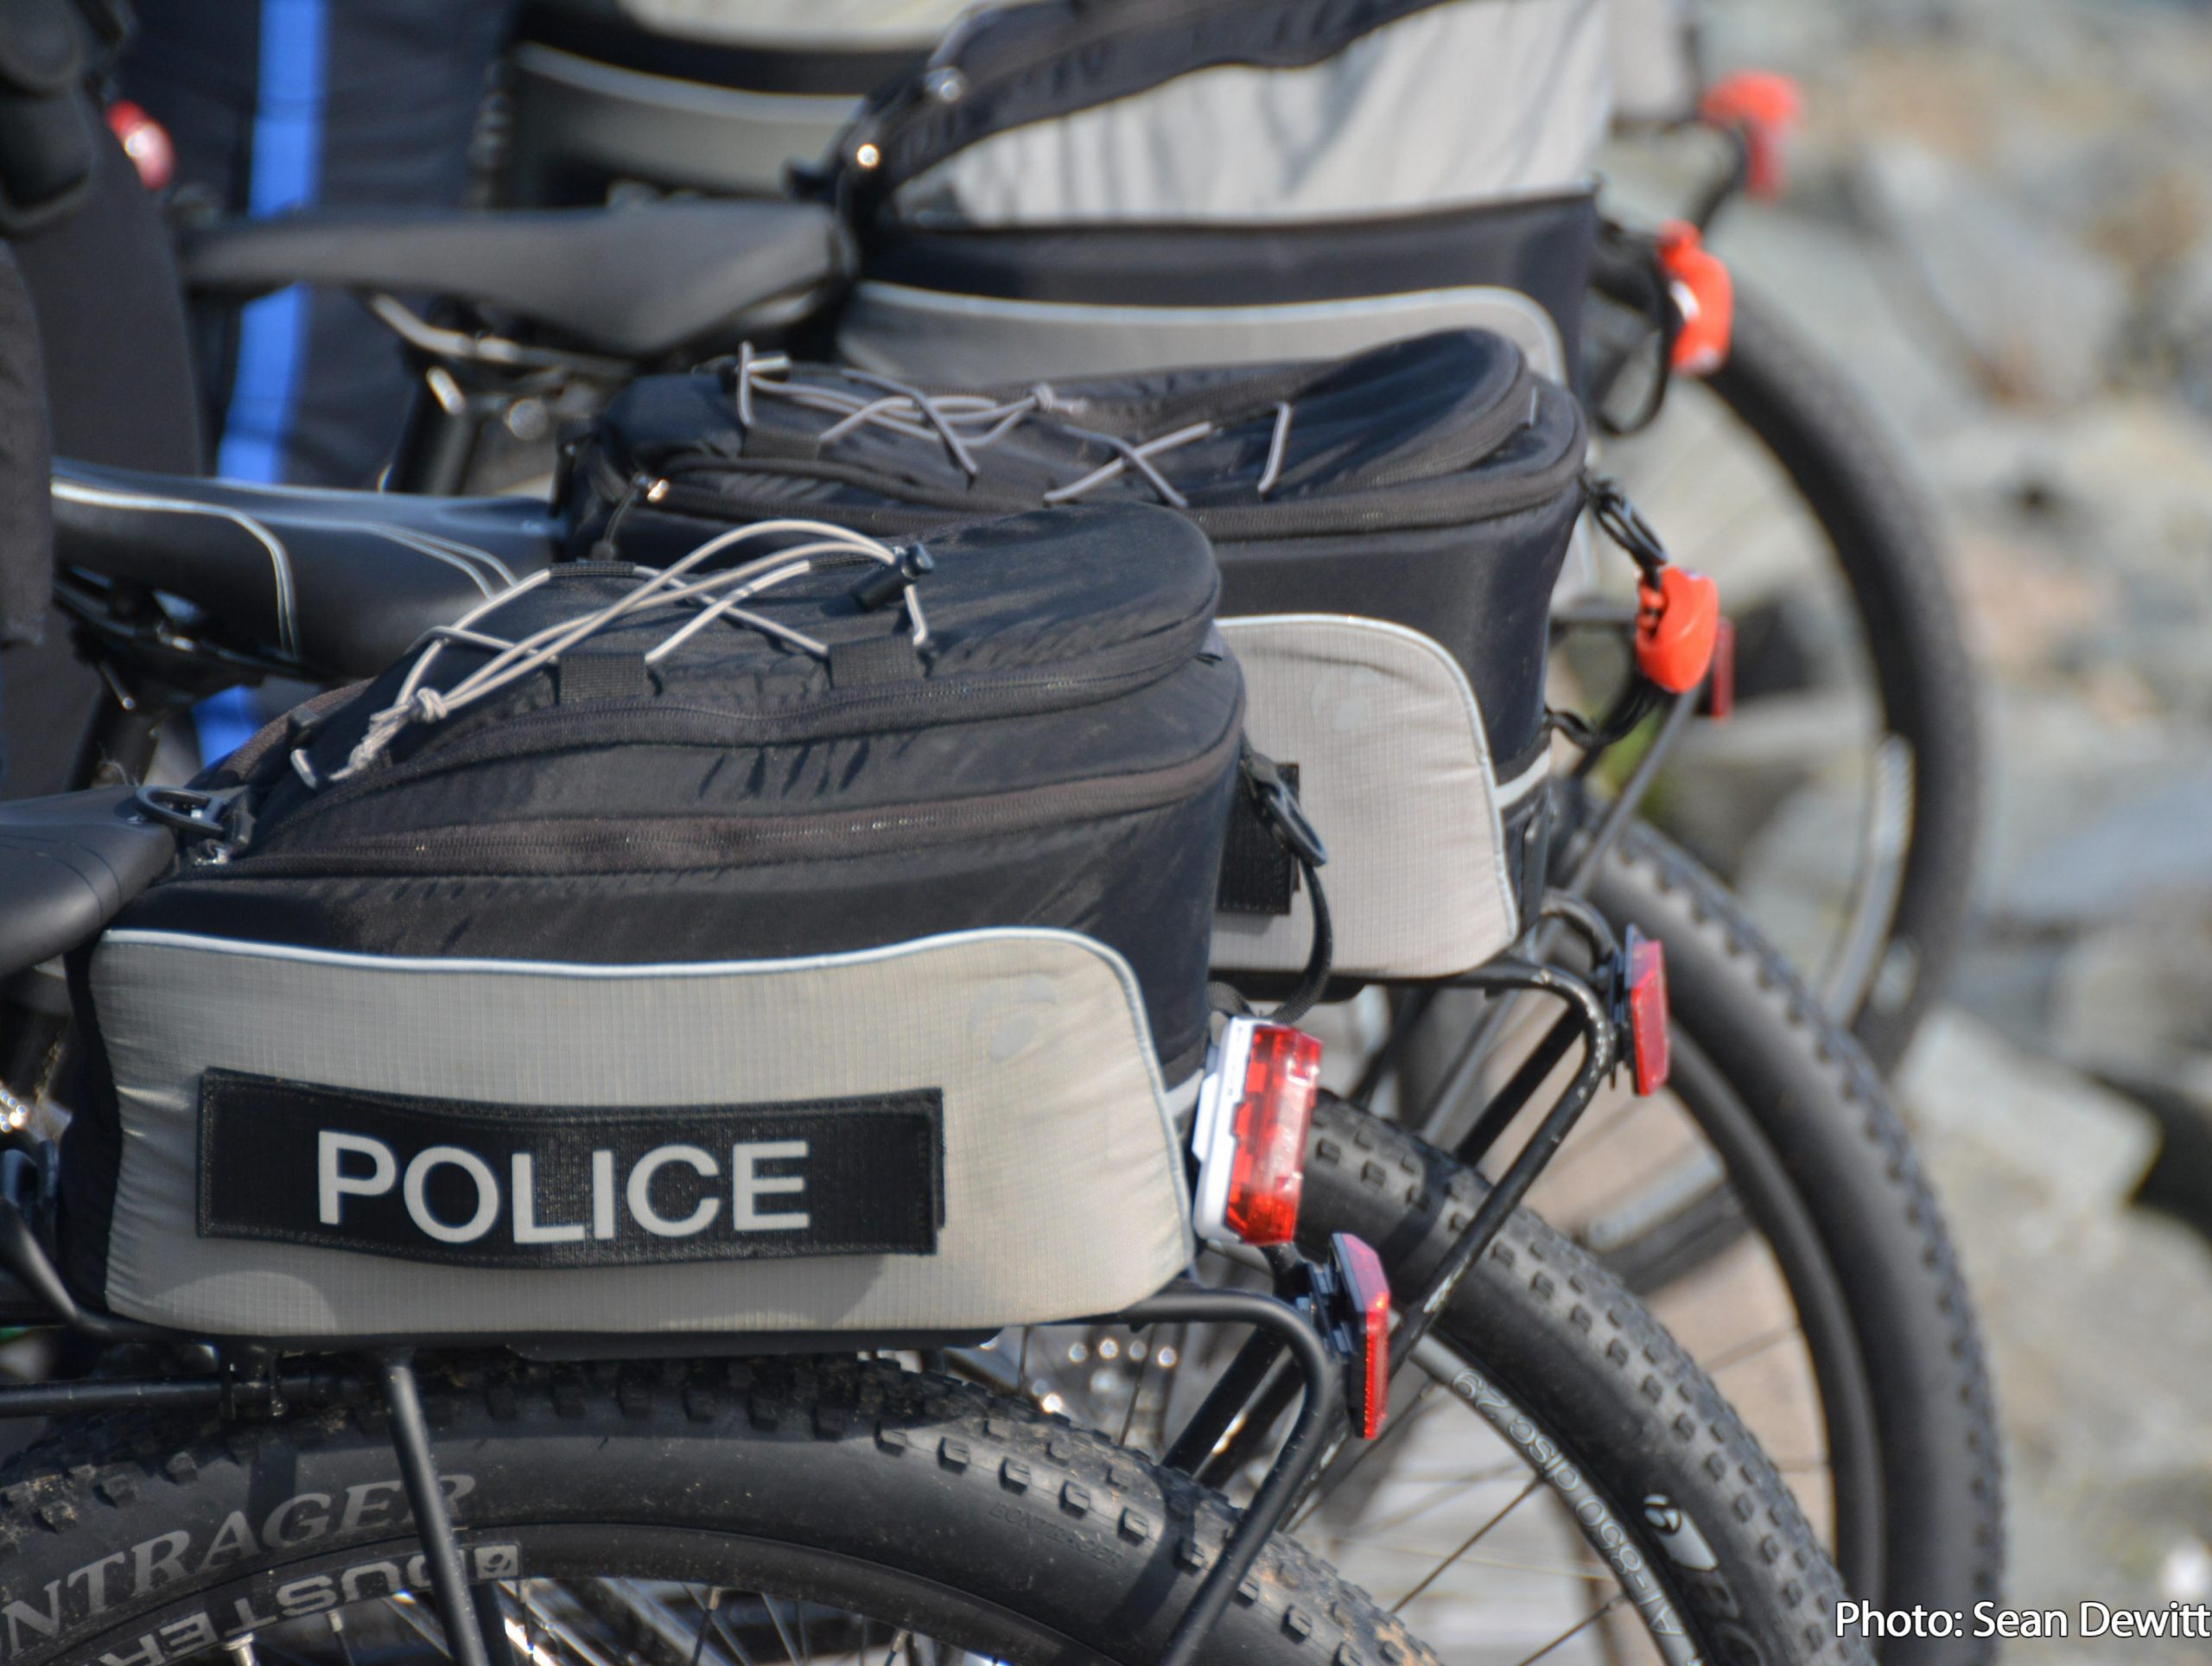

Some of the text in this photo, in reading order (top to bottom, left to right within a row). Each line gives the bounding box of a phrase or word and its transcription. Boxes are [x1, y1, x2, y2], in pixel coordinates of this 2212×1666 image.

[318, 1130, 810, 1244] POLICE
[1452, 1368, 1510, 1421] 29
[1509, 1414, 1581, 1492] disc
[0, 1473, 475, 1659] NTRAGER
